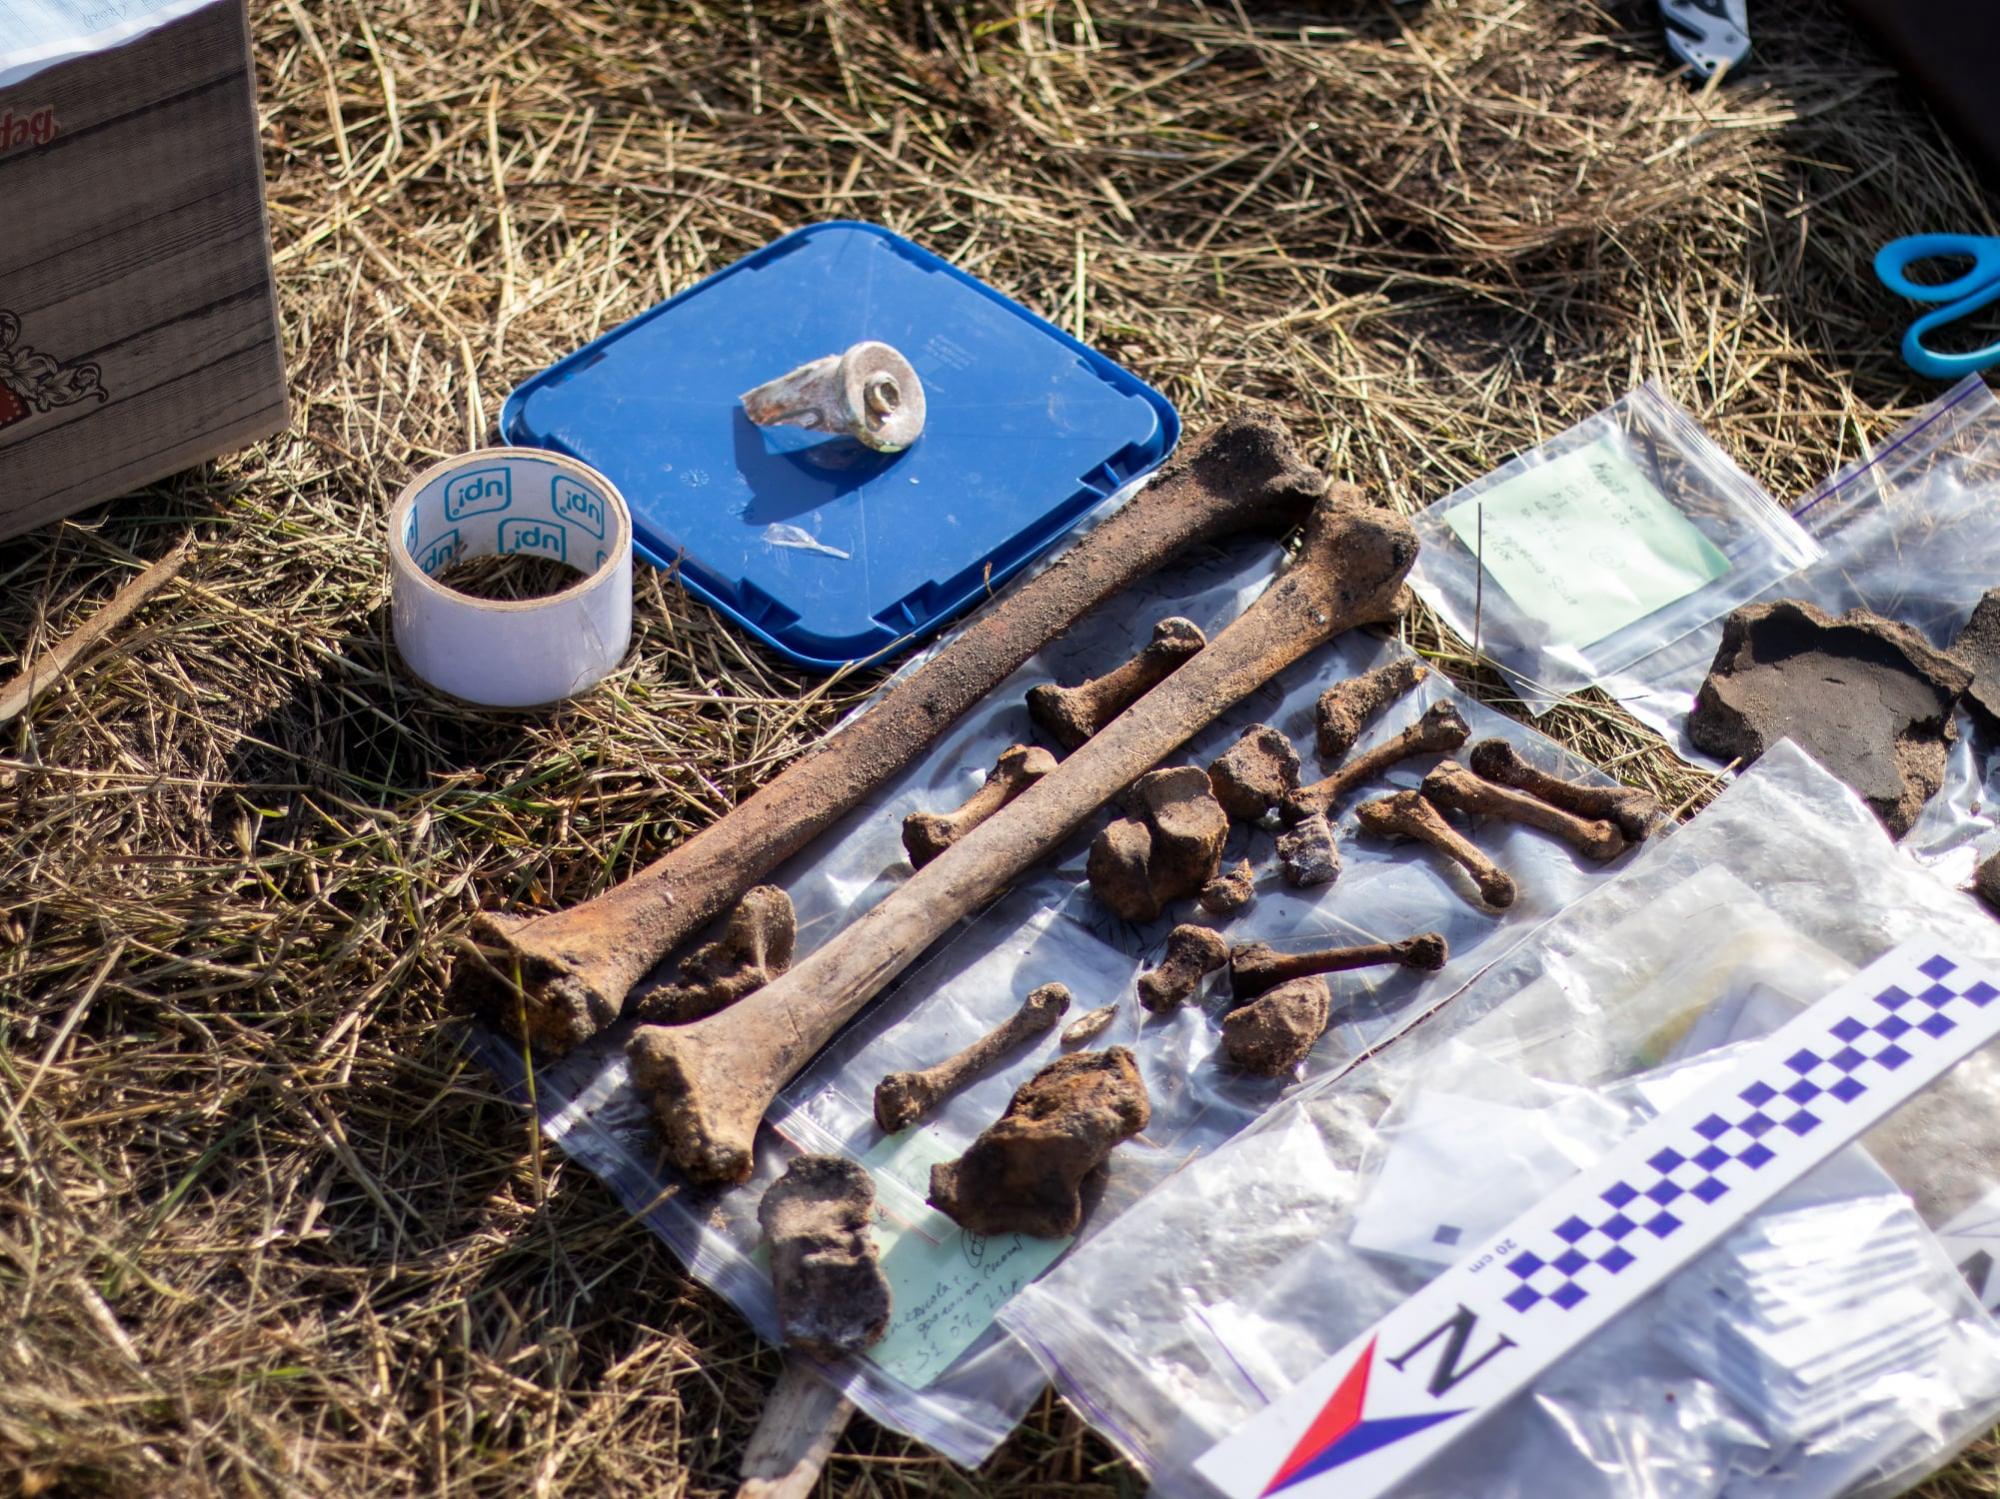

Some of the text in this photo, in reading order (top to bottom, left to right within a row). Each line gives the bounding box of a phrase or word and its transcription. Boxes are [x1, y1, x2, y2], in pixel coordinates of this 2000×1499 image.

[458, 477, 503, 507] up!
[566, 490, 601, 524] up!
[514, 527, 559, 553] up!
[419, 544, 453, 574] up
[1468, 1238, 1518, 1274] 20 cm
[1385, 1302, 1519, 1399] N
